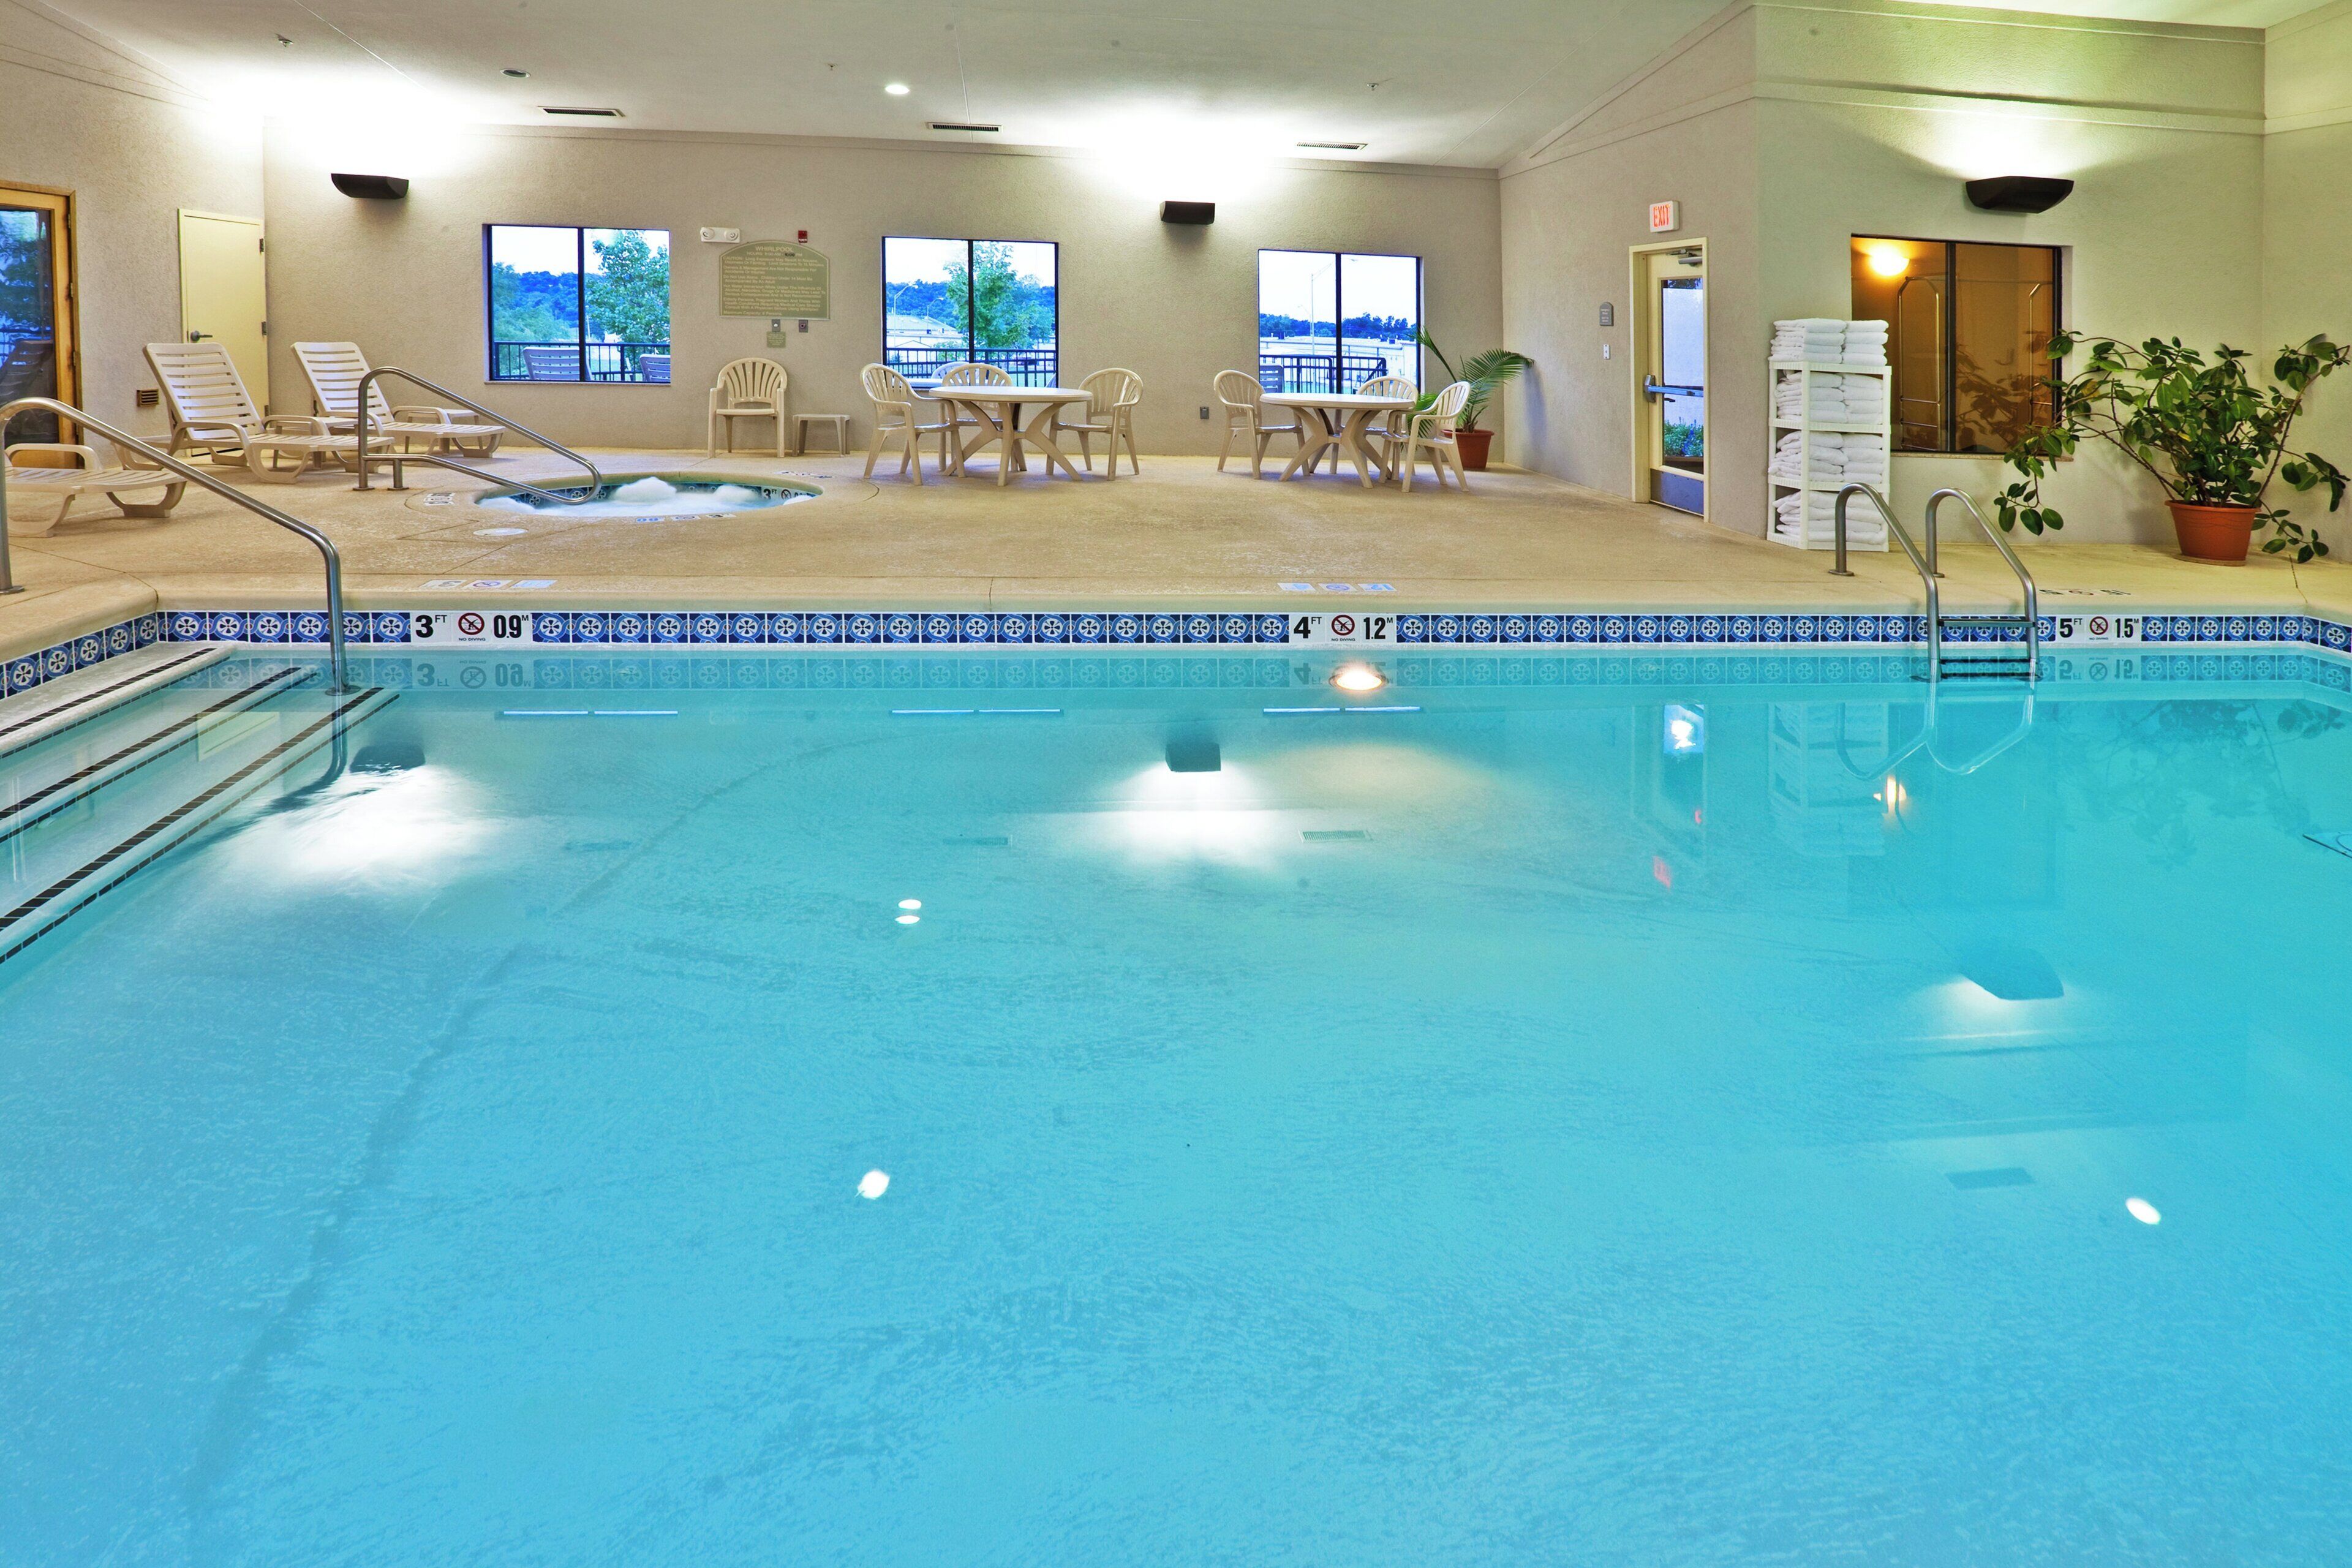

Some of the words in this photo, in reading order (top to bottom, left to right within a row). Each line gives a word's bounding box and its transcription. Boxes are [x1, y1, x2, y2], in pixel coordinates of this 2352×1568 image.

[1653, 204, 1670, 227] EXIT
[416, 615, 434, 638] 3
[1294, 617, 1311, 639] 4
[2060, 618, 2073, 638] 5
